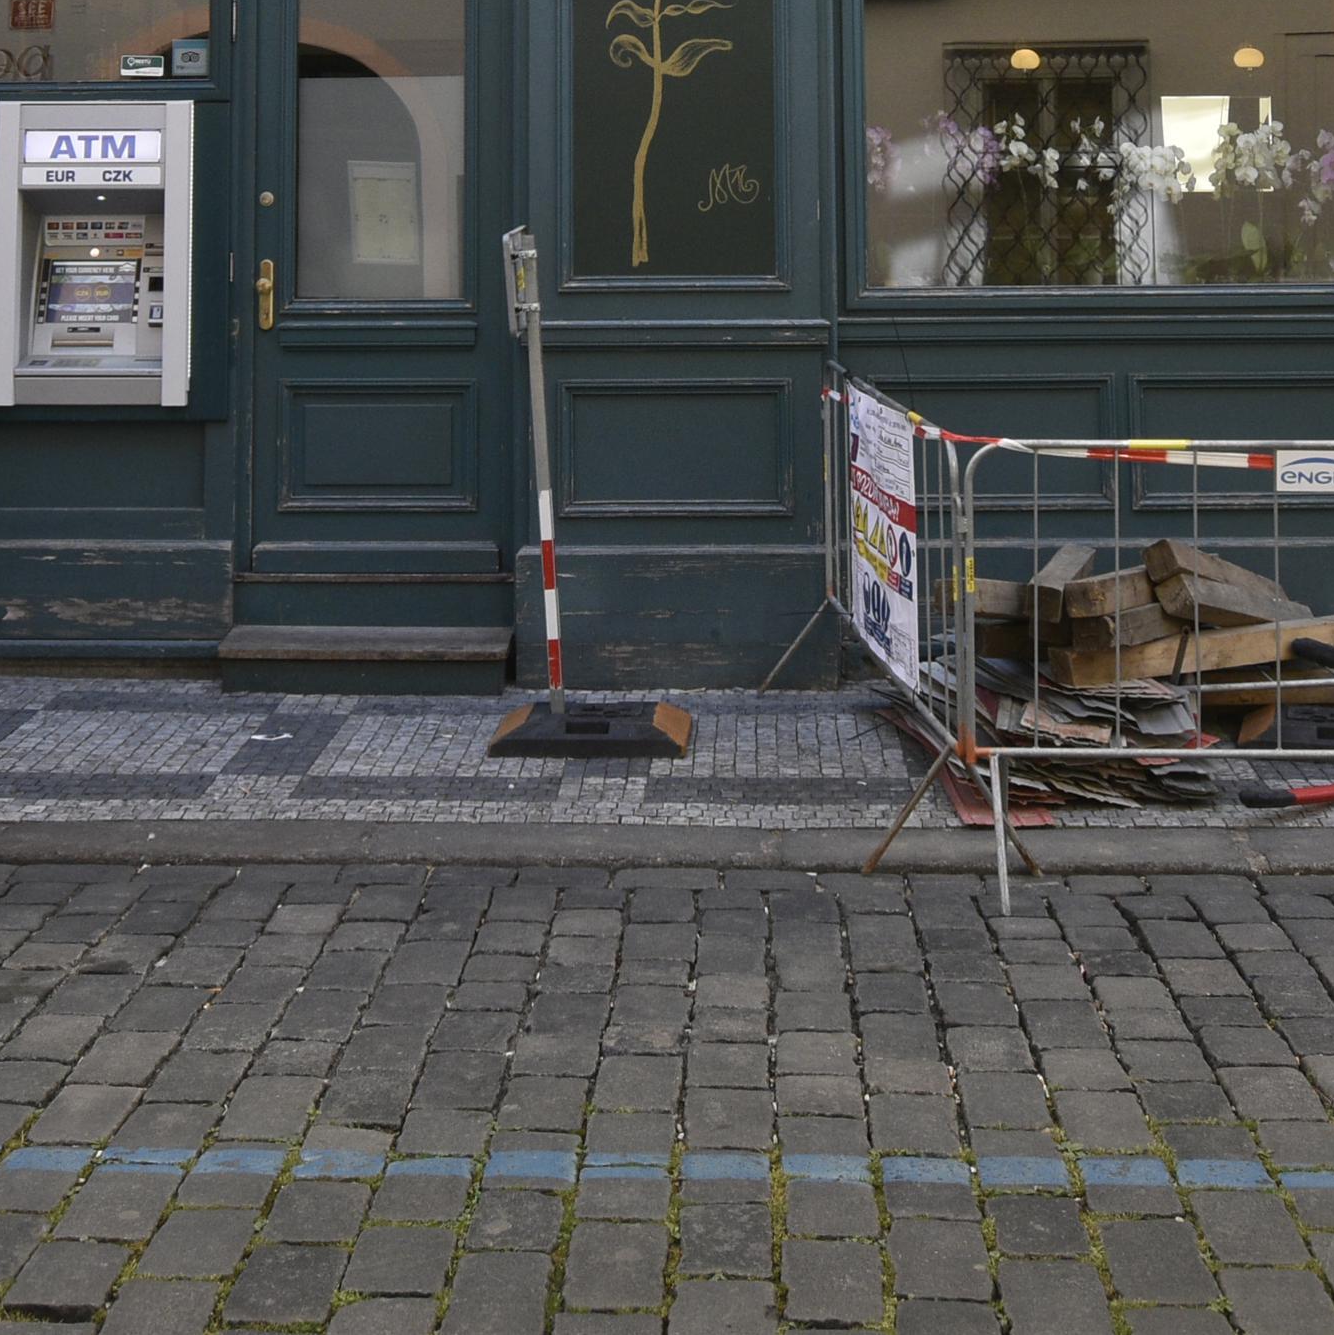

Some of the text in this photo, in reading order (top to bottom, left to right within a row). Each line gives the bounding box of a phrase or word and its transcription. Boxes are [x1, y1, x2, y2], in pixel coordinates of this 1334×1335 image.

[49, 135, 136, 159] ATM
[46, 170, 133, 182] EUR CZK
